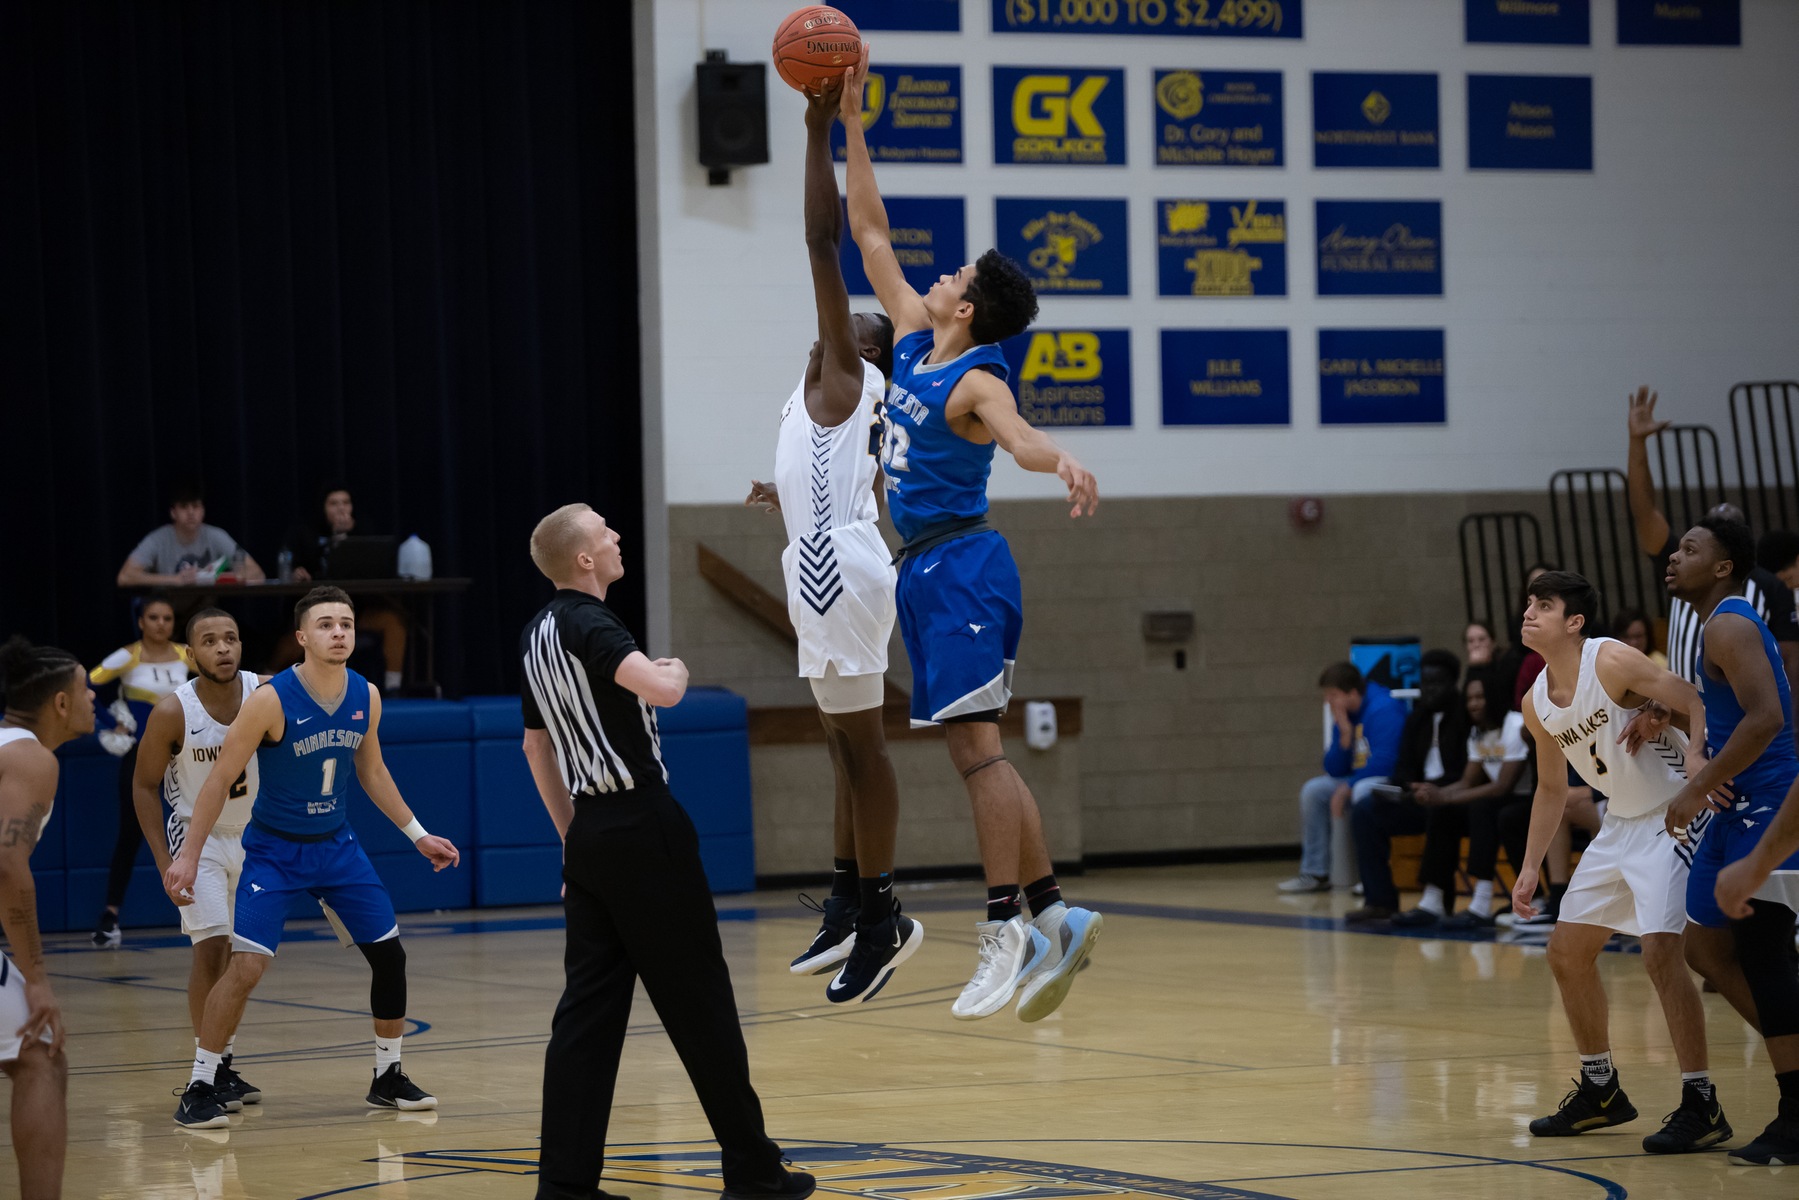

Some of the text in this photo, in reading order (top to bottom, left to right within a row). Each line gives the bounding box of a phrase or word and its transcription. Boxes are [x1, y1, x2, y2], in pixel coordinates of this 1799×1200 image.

[1128, 0, 1168, 26] TO
[807, 40, 860, 55] SPALDING
[1012, 75, 1109, 137] GK
[1164, 124, 1188, 143] Dr.
[1232, 123, 1263, 142] and
[1158, 145, 1226, 162] Michelle
[1018, 382, 1105, 405] Business
[1019, 404, 1106, 426] Solutions
[192, 745, 222, 762] IOW
[321, 758, 337, 796] 1
[856, 1149, 954, 1161] IOWA
[956, 1158, 1074, 1174] LAKES
